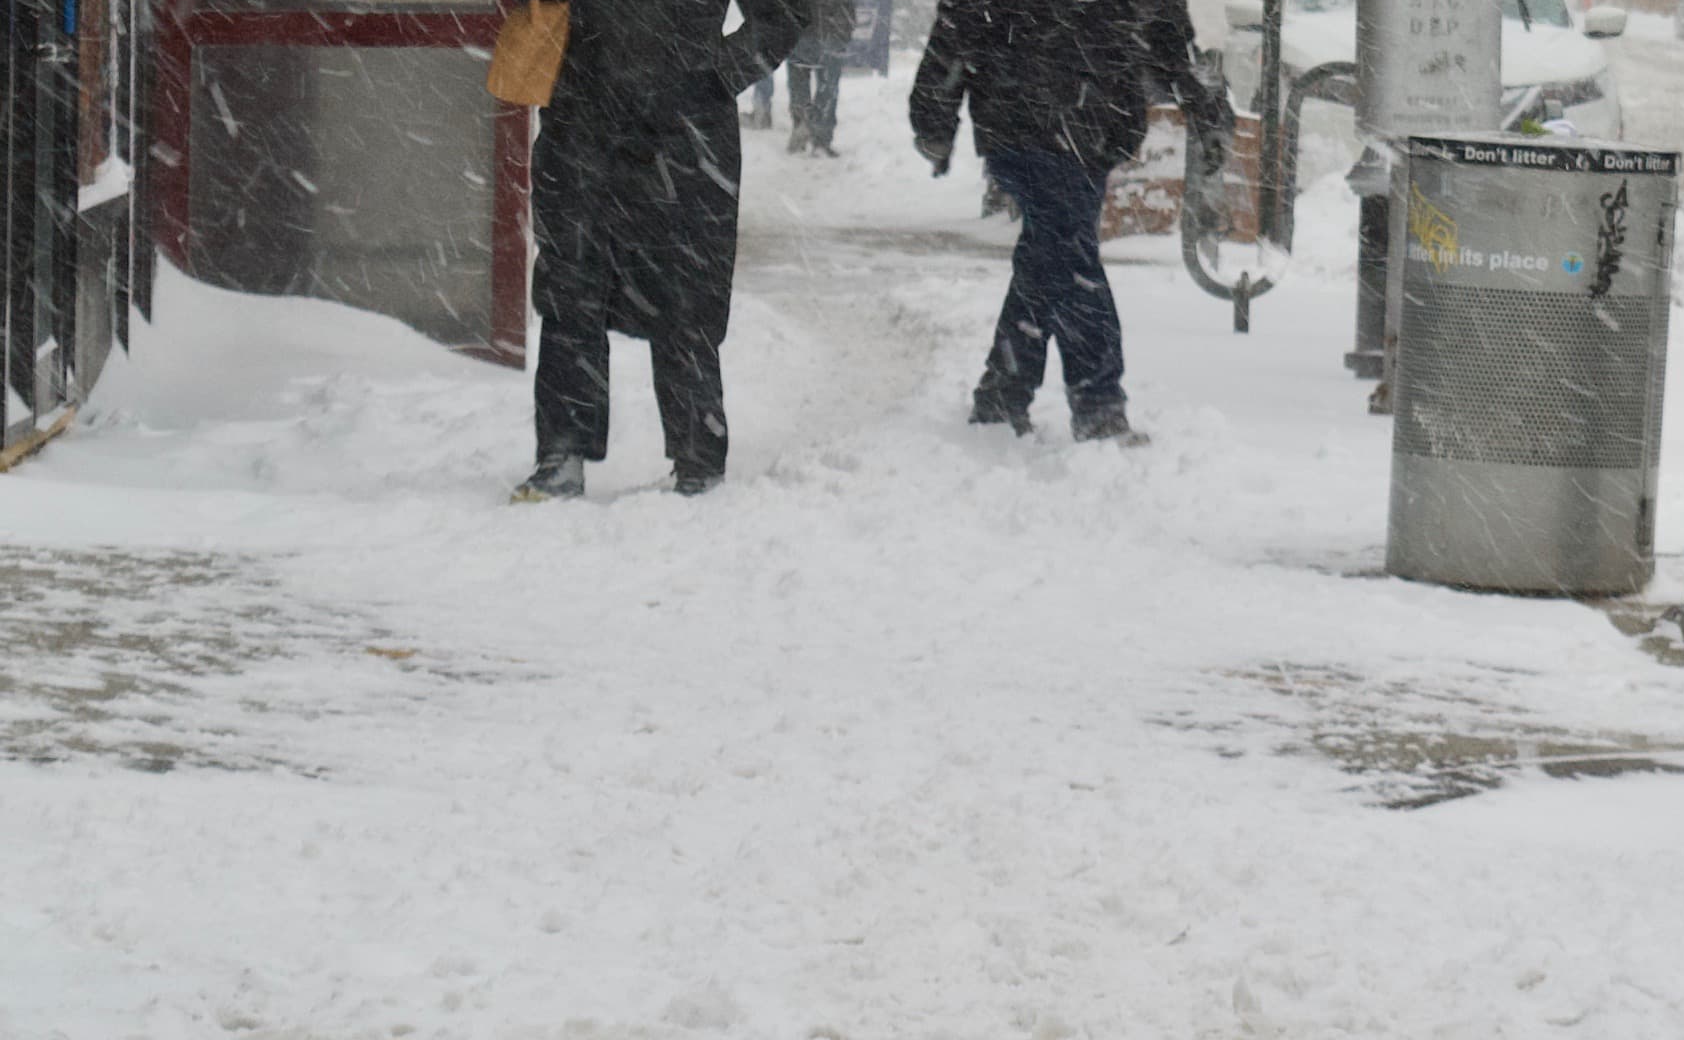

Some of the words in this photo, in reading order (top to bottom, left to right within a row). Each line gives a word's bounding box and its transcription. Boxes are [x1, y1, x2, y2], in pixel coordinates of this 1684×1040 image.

[1464, 145, 1507, 163] Don't
[1512, 147, 1556, 166] litter
[1603, 154, 1643, 171] Don't
[1488, 249, 1550, 272] place
